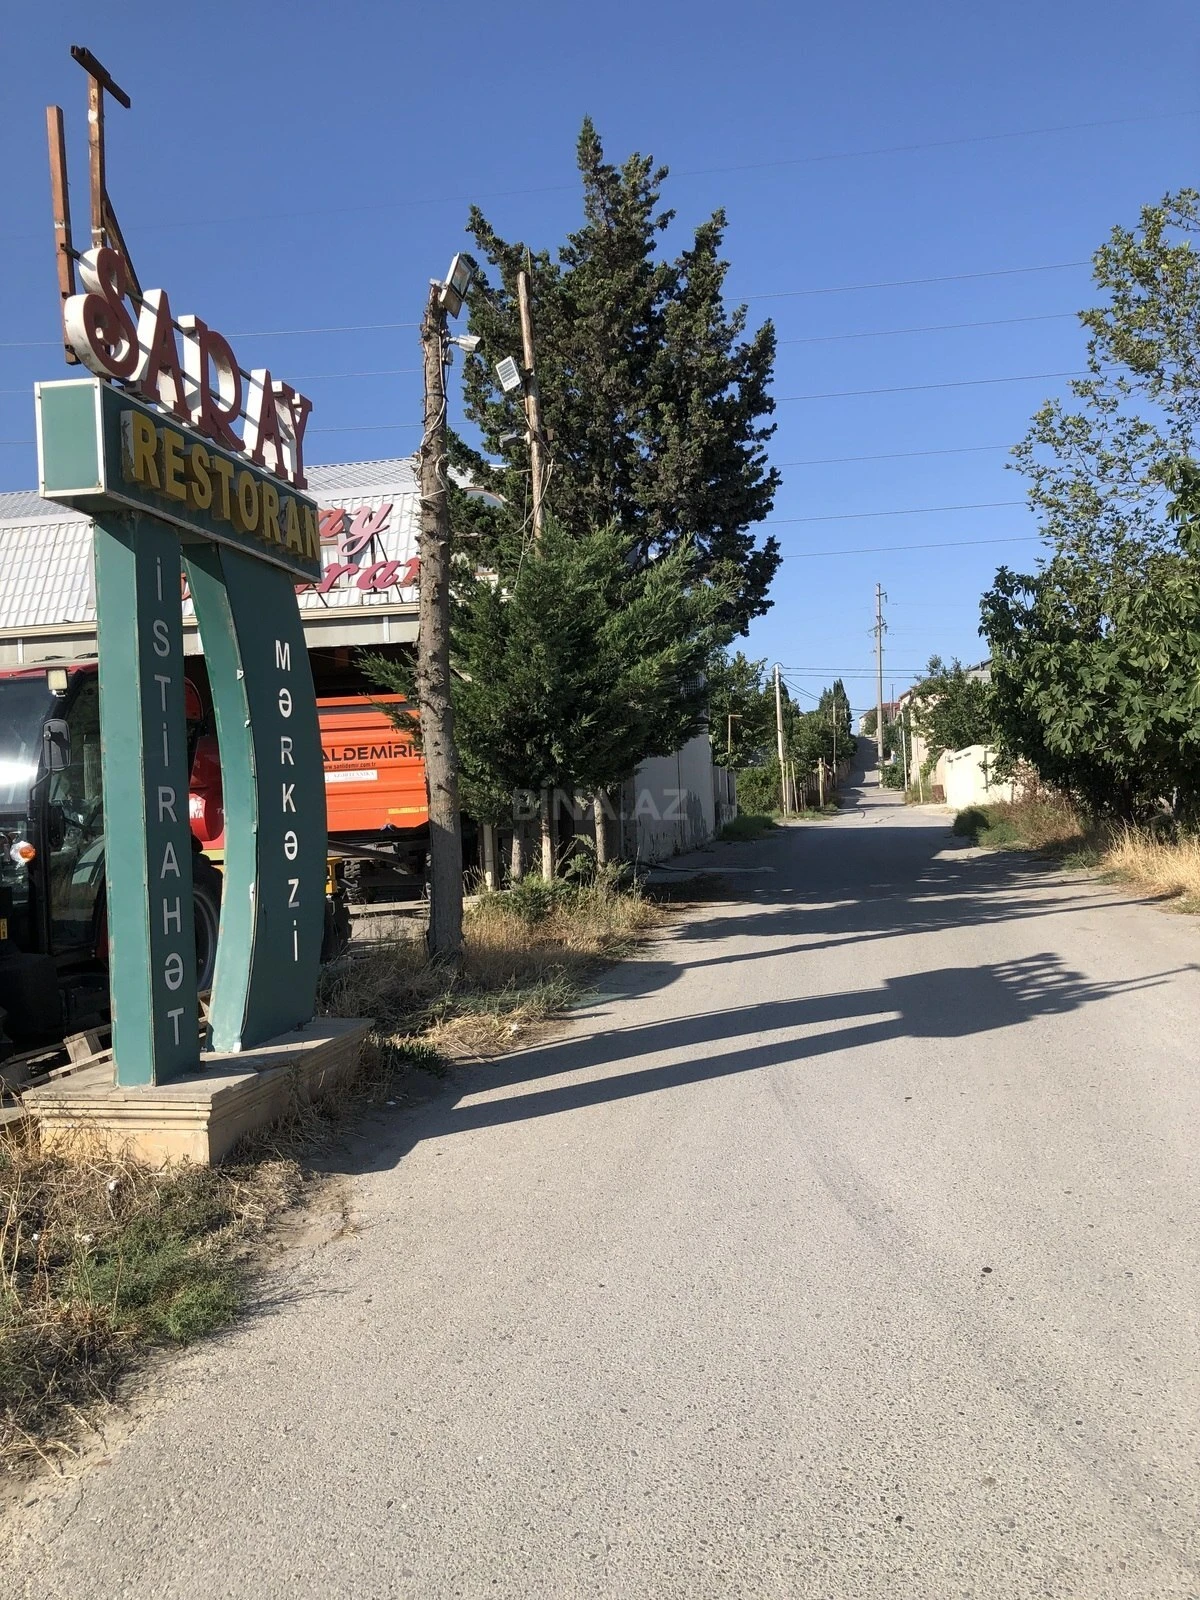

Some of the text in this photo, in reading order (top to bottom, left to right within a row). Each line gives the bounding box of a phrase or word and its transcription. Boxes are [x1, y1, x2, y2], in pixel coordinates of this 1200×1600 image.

[65, 247, 313, 490] SARAY
[121, 410, 320, 561] RESTORAN
[152, 556, 186, 1046] İSTİRAHƏT
[274, 639, 301, 962] MƏRKƏZİ
